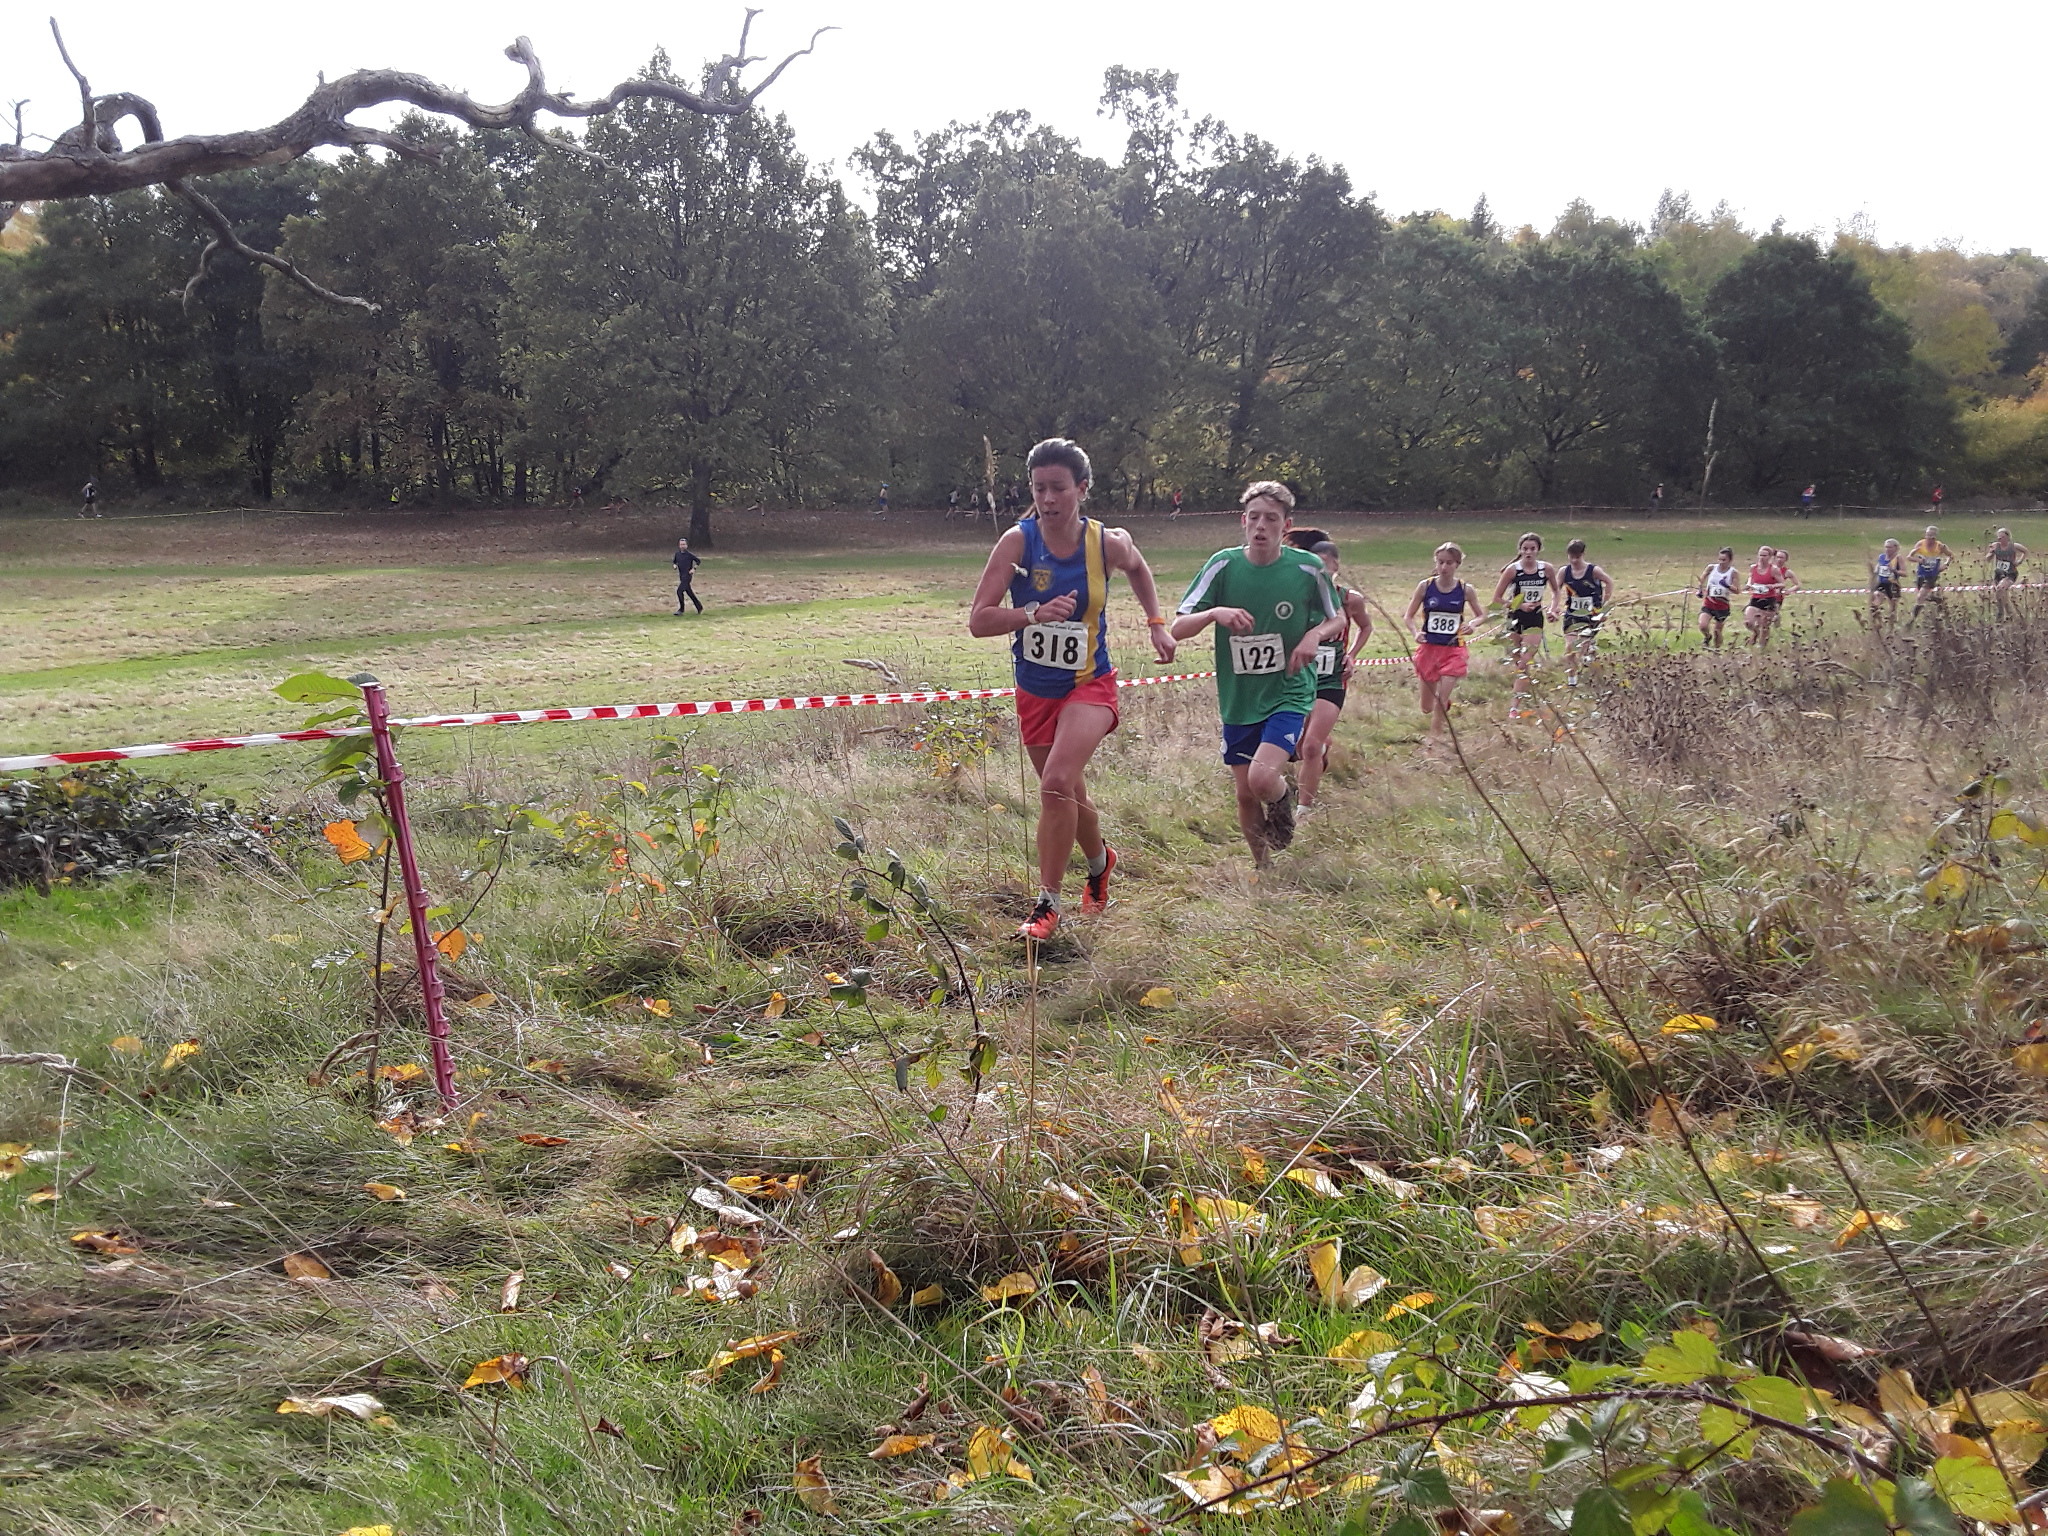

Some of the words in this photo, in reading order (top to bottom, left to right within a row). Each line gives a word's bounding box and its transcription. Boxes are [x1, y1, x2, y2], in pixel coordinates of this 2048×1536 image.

[1431, 617, 1455, 632] 388
[1031, 631, 1079, 664] 318
[1240, 646, 1276, 670] 122
